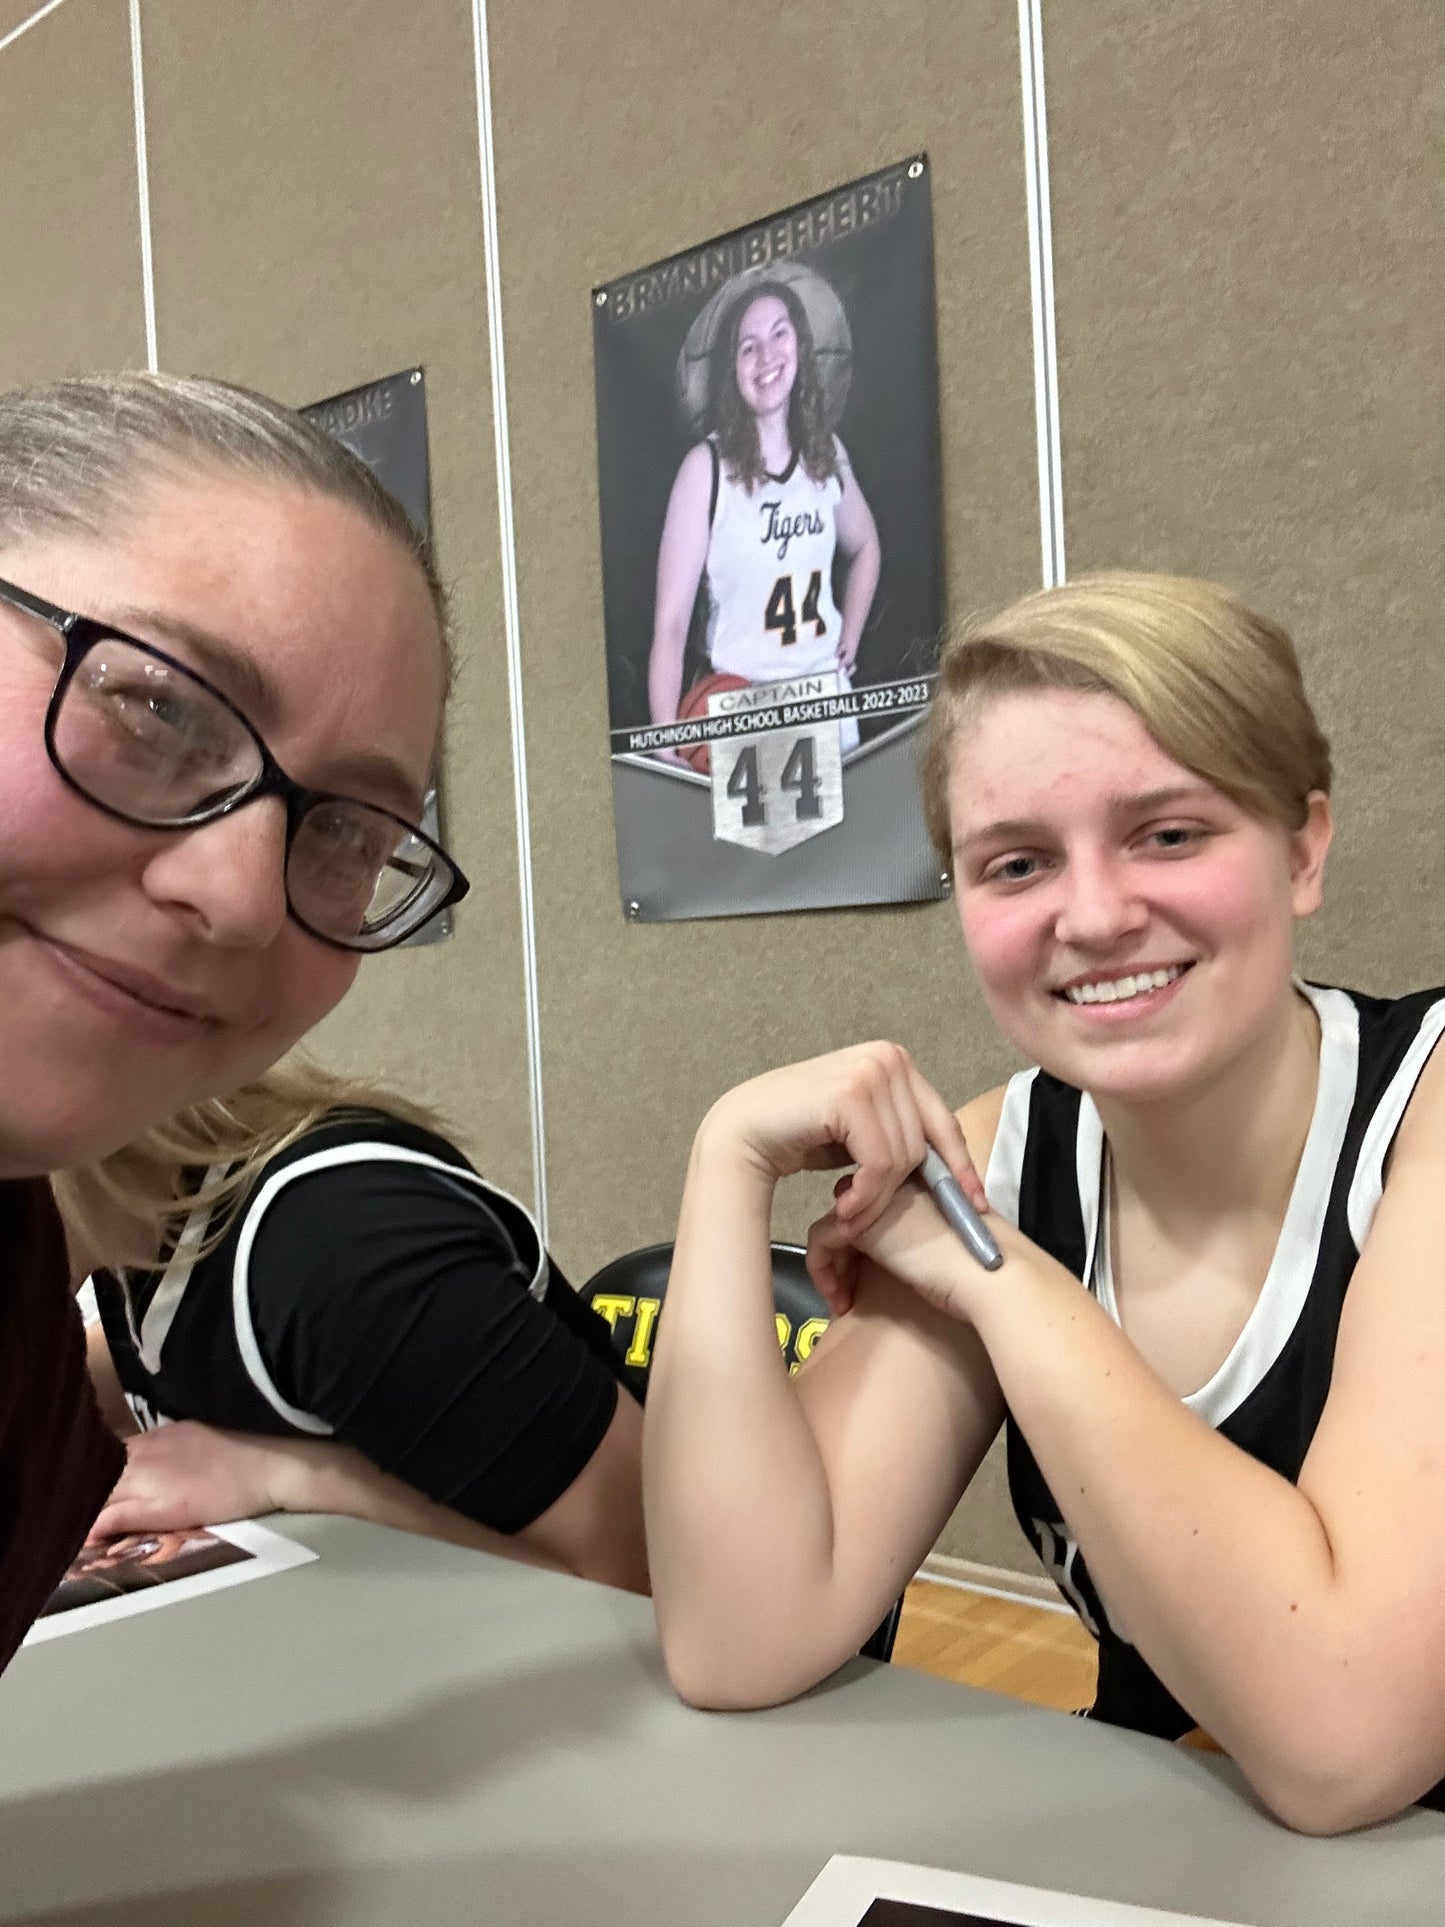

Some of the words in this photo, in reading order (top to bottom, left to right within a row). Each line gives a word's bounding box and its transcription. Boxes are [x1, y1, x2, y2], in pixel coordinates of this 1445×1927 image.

[760, 501, 824, 560] Tigers
[764, 570, 827, 648] 44
[629, 722, 702, 749] HUTCHINSON
[702, 716, 732, 737] HIGH
[733, 707, 783, 731] SCHOOL
[783, 695, 860, 724] BASKETBALL
[861, 682, 929, 711] 2022-2023
[719, 679, 823, 711] CAPTAIN
[726, 736, 824, 829] 44
